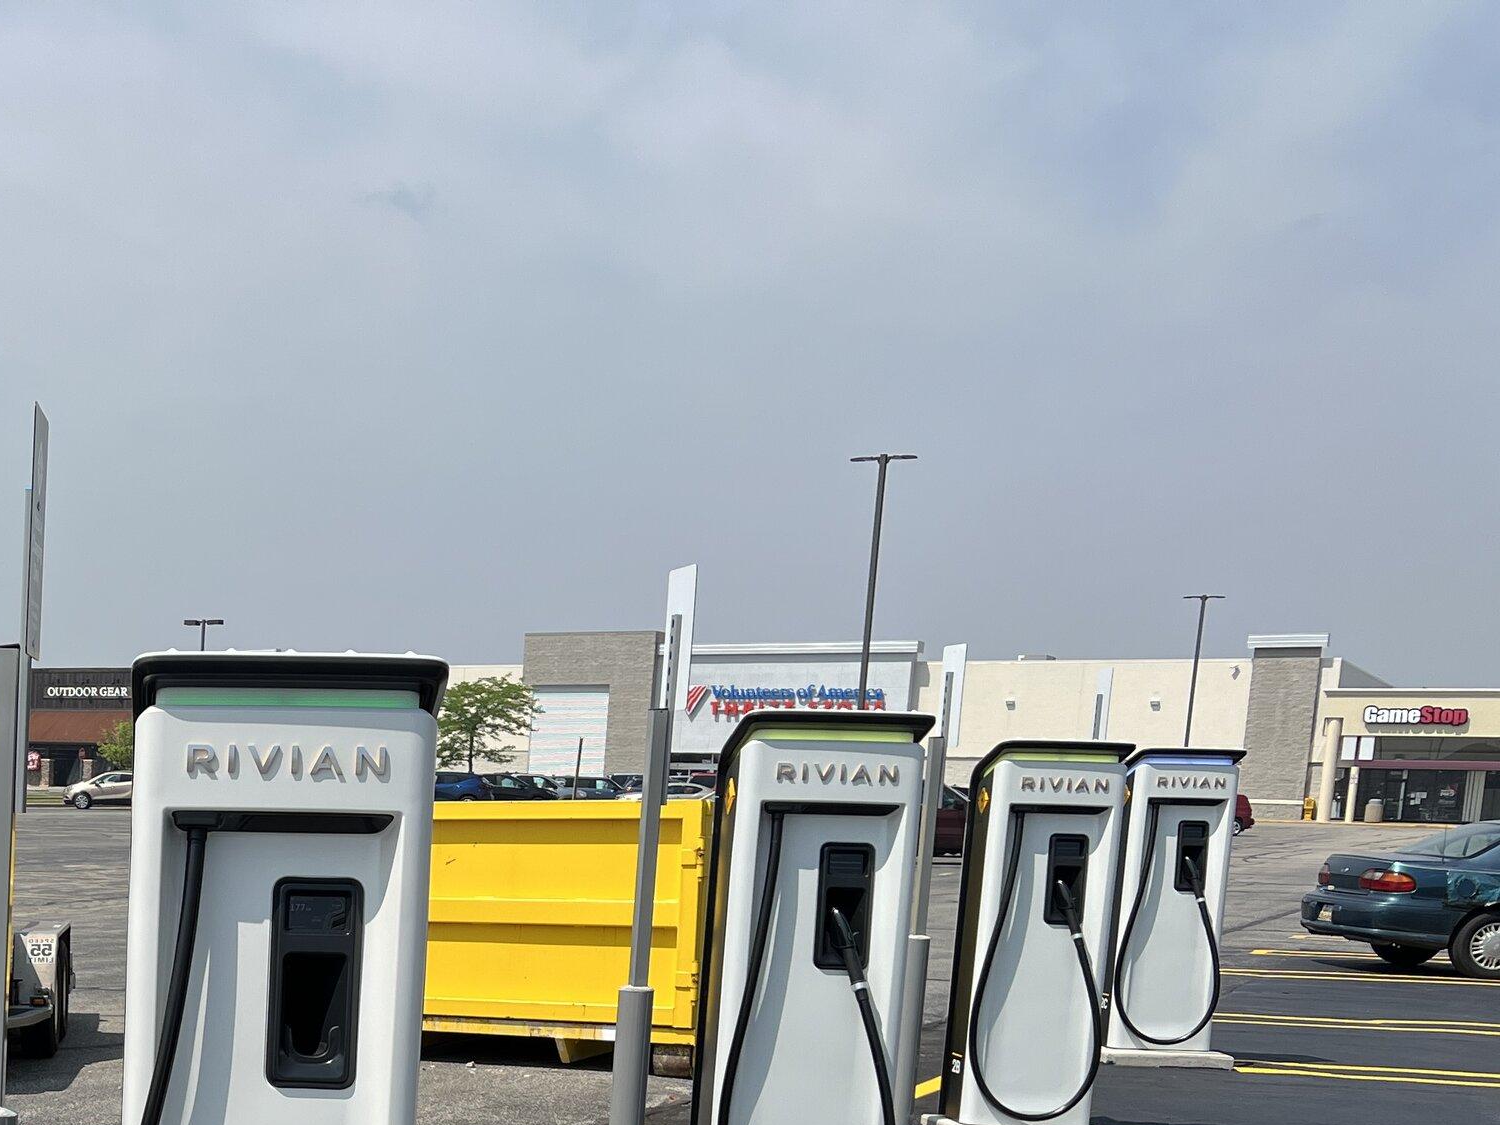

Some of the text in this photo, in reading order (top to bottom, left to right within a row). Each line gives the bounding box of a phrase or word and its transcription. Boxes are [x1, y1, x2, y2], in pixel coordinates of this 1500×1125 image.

[47, 686, 129, 697] OUTDOOR GEAR
[711, 684, 885, 700] Volunteers of Amerca
[1363, 705, 1469, 726] GameStop
[186, 743, 389, 778] RIVIAN
[776, 761, 900, 785] RIVIAN
[1020, 776, 1110, 794] RIVIAN
[1156, 776, 1227, 790] RIVIAN
